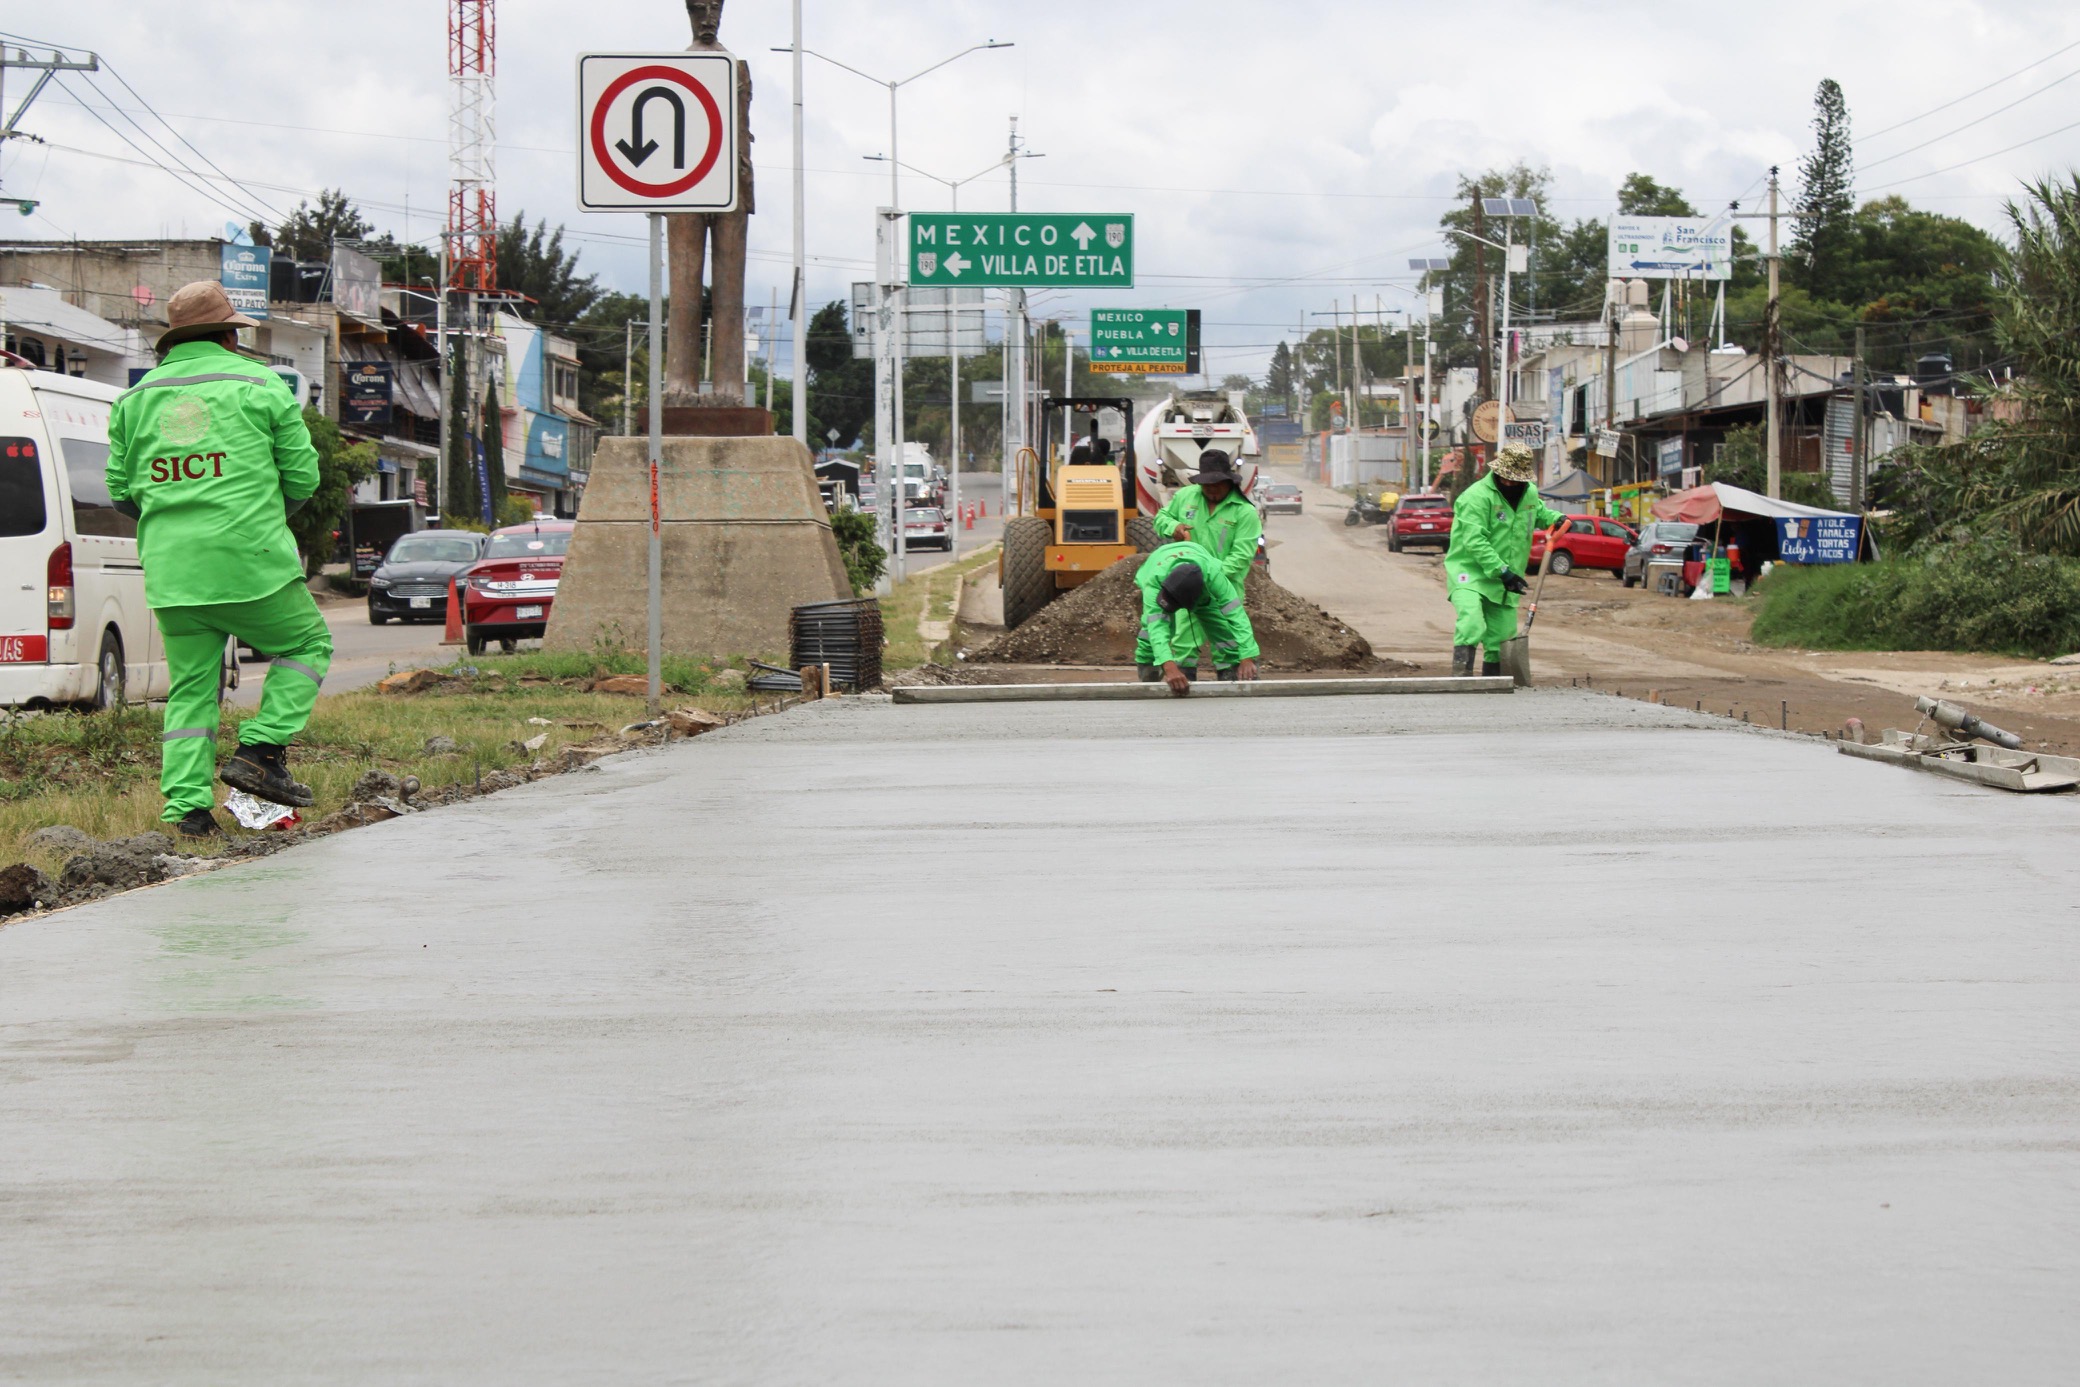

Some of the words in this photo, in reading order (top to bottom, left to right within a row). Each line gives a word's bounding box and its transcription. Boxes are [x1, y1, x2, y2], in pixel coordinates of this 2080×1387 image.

[1676, 225, 1695, 234] San
[917, 225, 1058, 245] MEXICO
[1109, 232, 1122, 242] 190
[1676, 235, 1726, 244] Francisco
[223, 260, 266, 273] Corona
[920, 260, 934, 271] 190
[980, 255, 1038, 276] VILLA
[1045, 255, 1069, 276] DE
[1075, 255, 1125, 276] ETLA
[234, 272, 258, 281] Extra
[245, 299, 266, 308] PATO
[1097, 313, 1144, 322] MEXICO
[1097, 330, 1144, 339] PUEBLA
[1126, 347, 1148, 356] VILLA
[1150, 347, 1160, 356] DE
[1161, 347, 1182, 356] ETLA
[1092, 364, 1133, 372] PROTEJA
[1136, 364, 1146, 372] AL
[1149, 364, 1184, 372] PEATON
[351, 373, 386, 385] Corona
[1505, 424, 1541, 438] VISAS
[151, 452, 227, 483] SICT
[1817, 519, 1846, 528] ATOLE
[1817, 529, 1855, 538] TAMALES
[1817, 539, 1849, 548] TORTAS
[1817, 549, 1844, 558] TACOS
